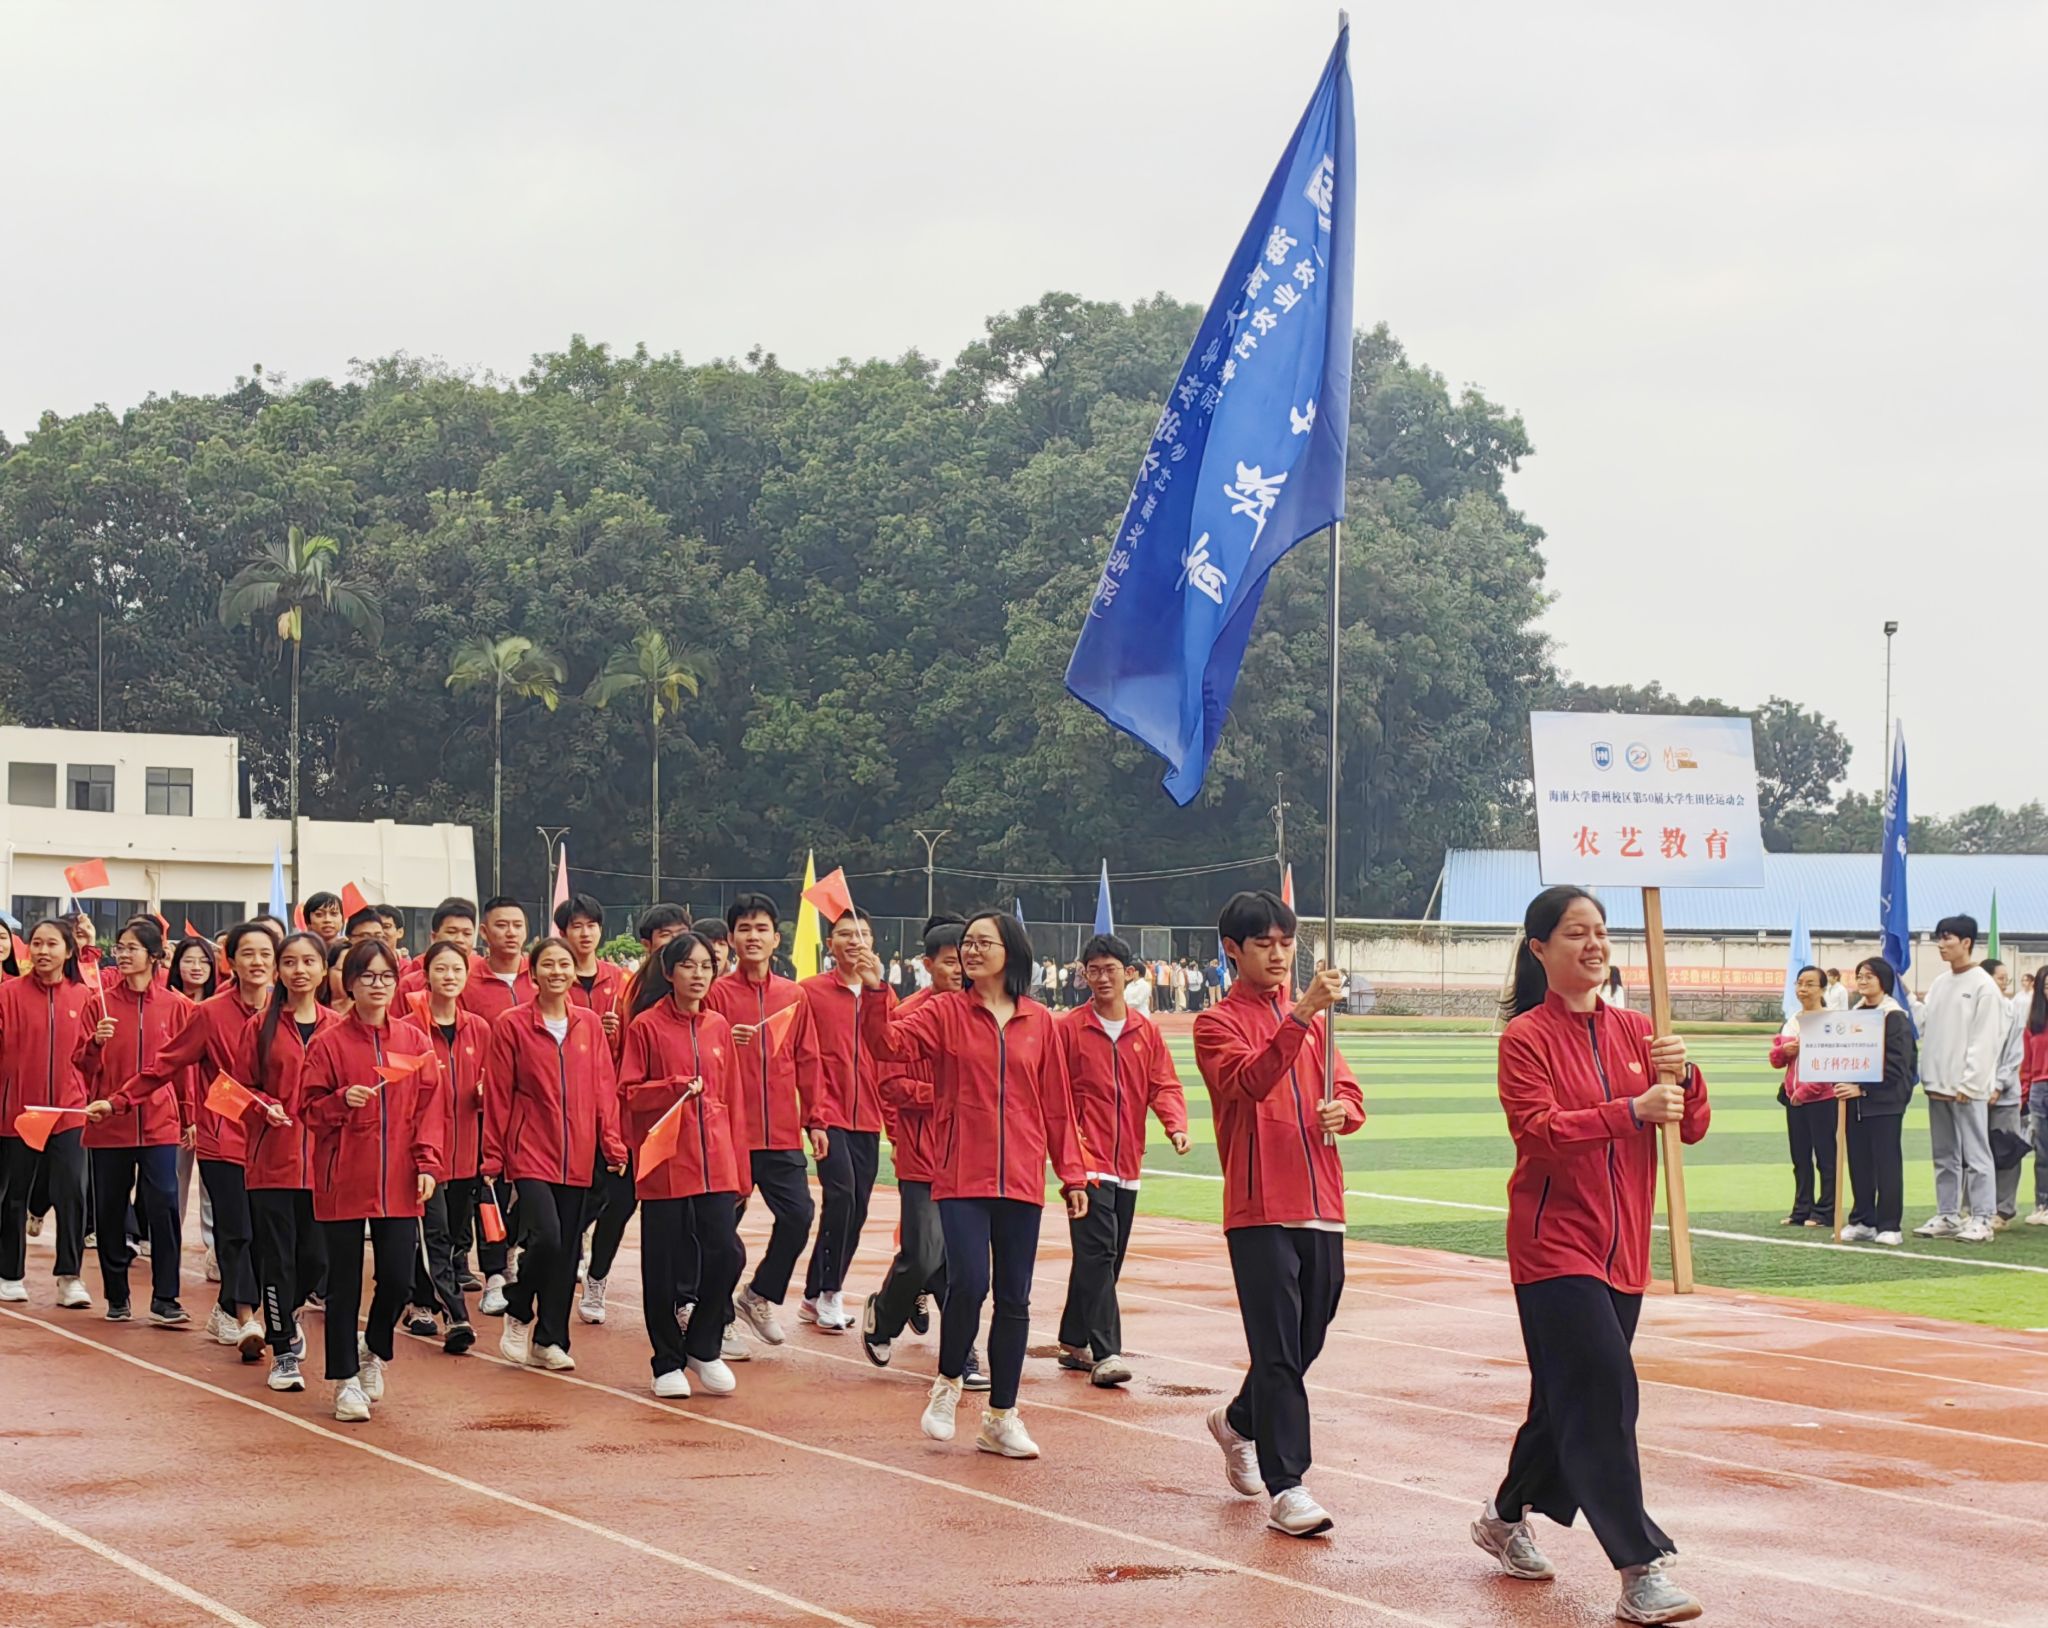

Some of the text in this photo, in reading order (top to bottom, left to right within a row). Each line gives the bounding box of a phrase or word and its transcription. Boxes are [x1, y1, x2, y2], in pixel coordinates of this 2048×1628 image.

[1572, 825, 1730, 860] 农艺教育
[1811, 1056, 1871, 1072] 电子科学技术
